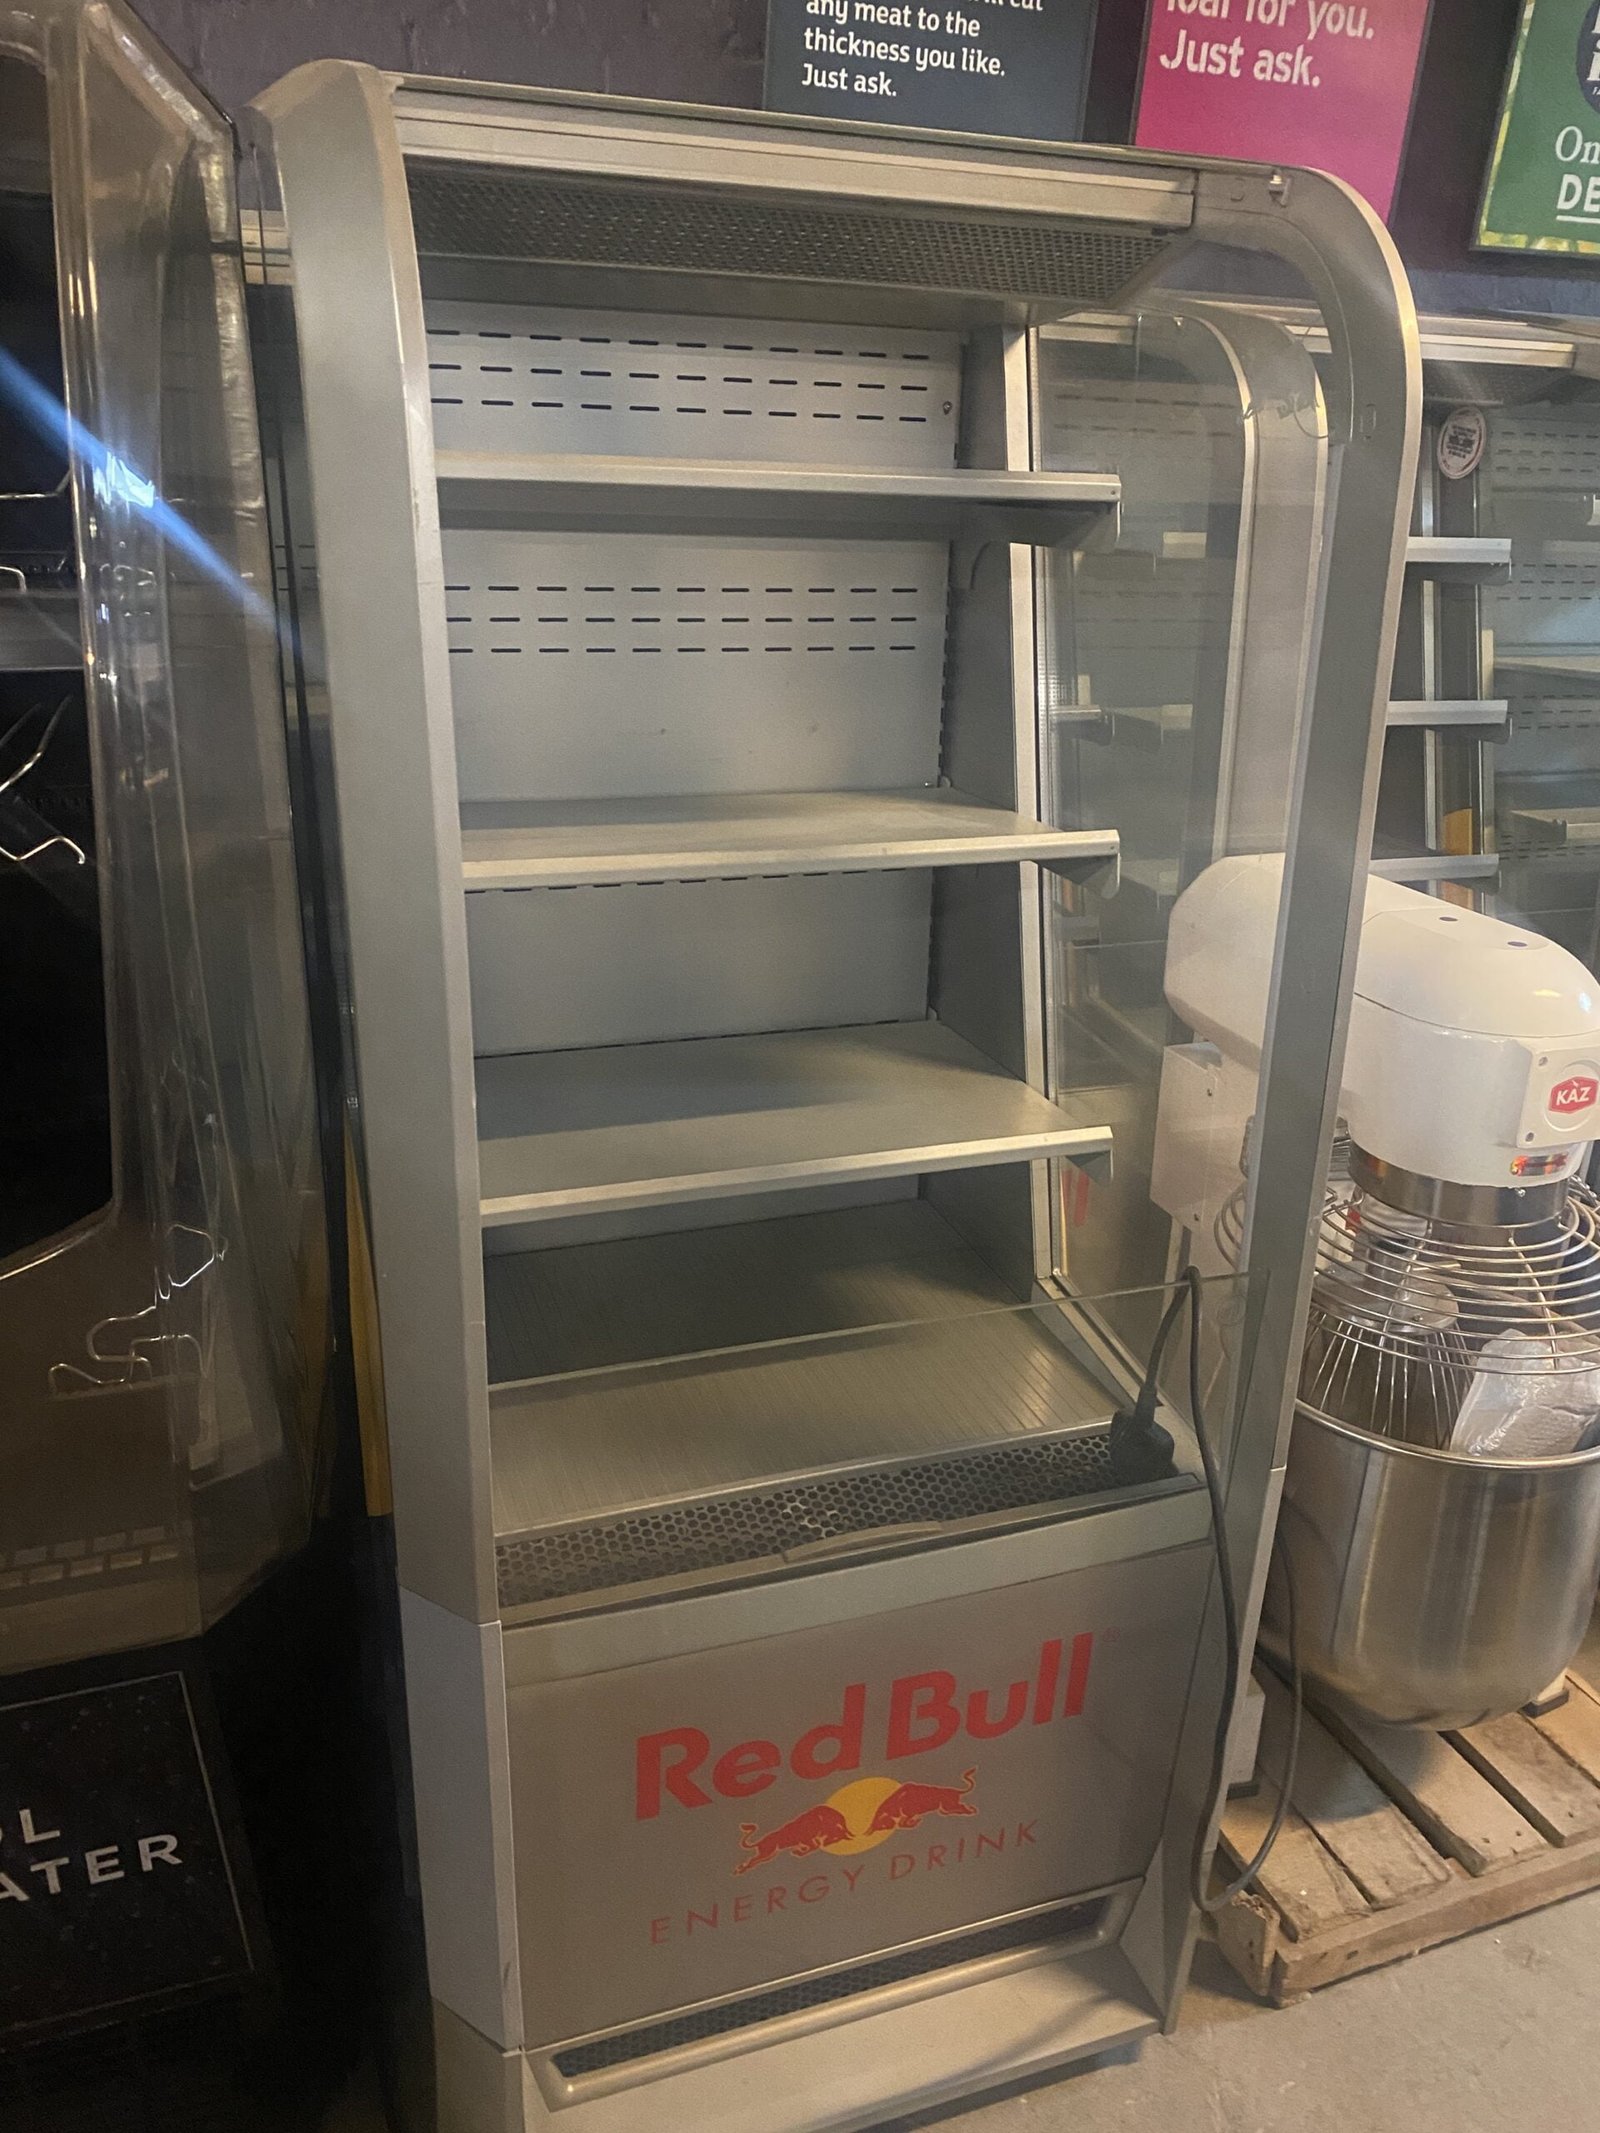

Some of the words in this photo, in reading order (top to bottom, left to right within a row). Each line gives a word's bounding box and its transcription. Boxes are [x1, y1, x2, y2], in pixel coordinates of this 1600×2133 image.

[806, 0, 848, 24] any
[854, 3, 912, 28] meat
[917, 7, 940, 31] to
[945, 11, 981, 37] the
[1306, 0, 1375, 41] you.
[804, 27, 910, 63] thickness
[915, 47, 956, 72] you
[961, 47, 1006, 77] like.
[1159, 29, 1245, 78] Just
[1253, 44, 1321, 87] ask.
[801, 63, 848, 90] Just
[853, 71, 897, 97] ask.
[635, 1683, 867, 1822] Red
[885, 1631, 1095, 1762] Bull
[649, 1864, 867, 1946] ENERGY
[890, 1818, 1042, 1882] DRINK
